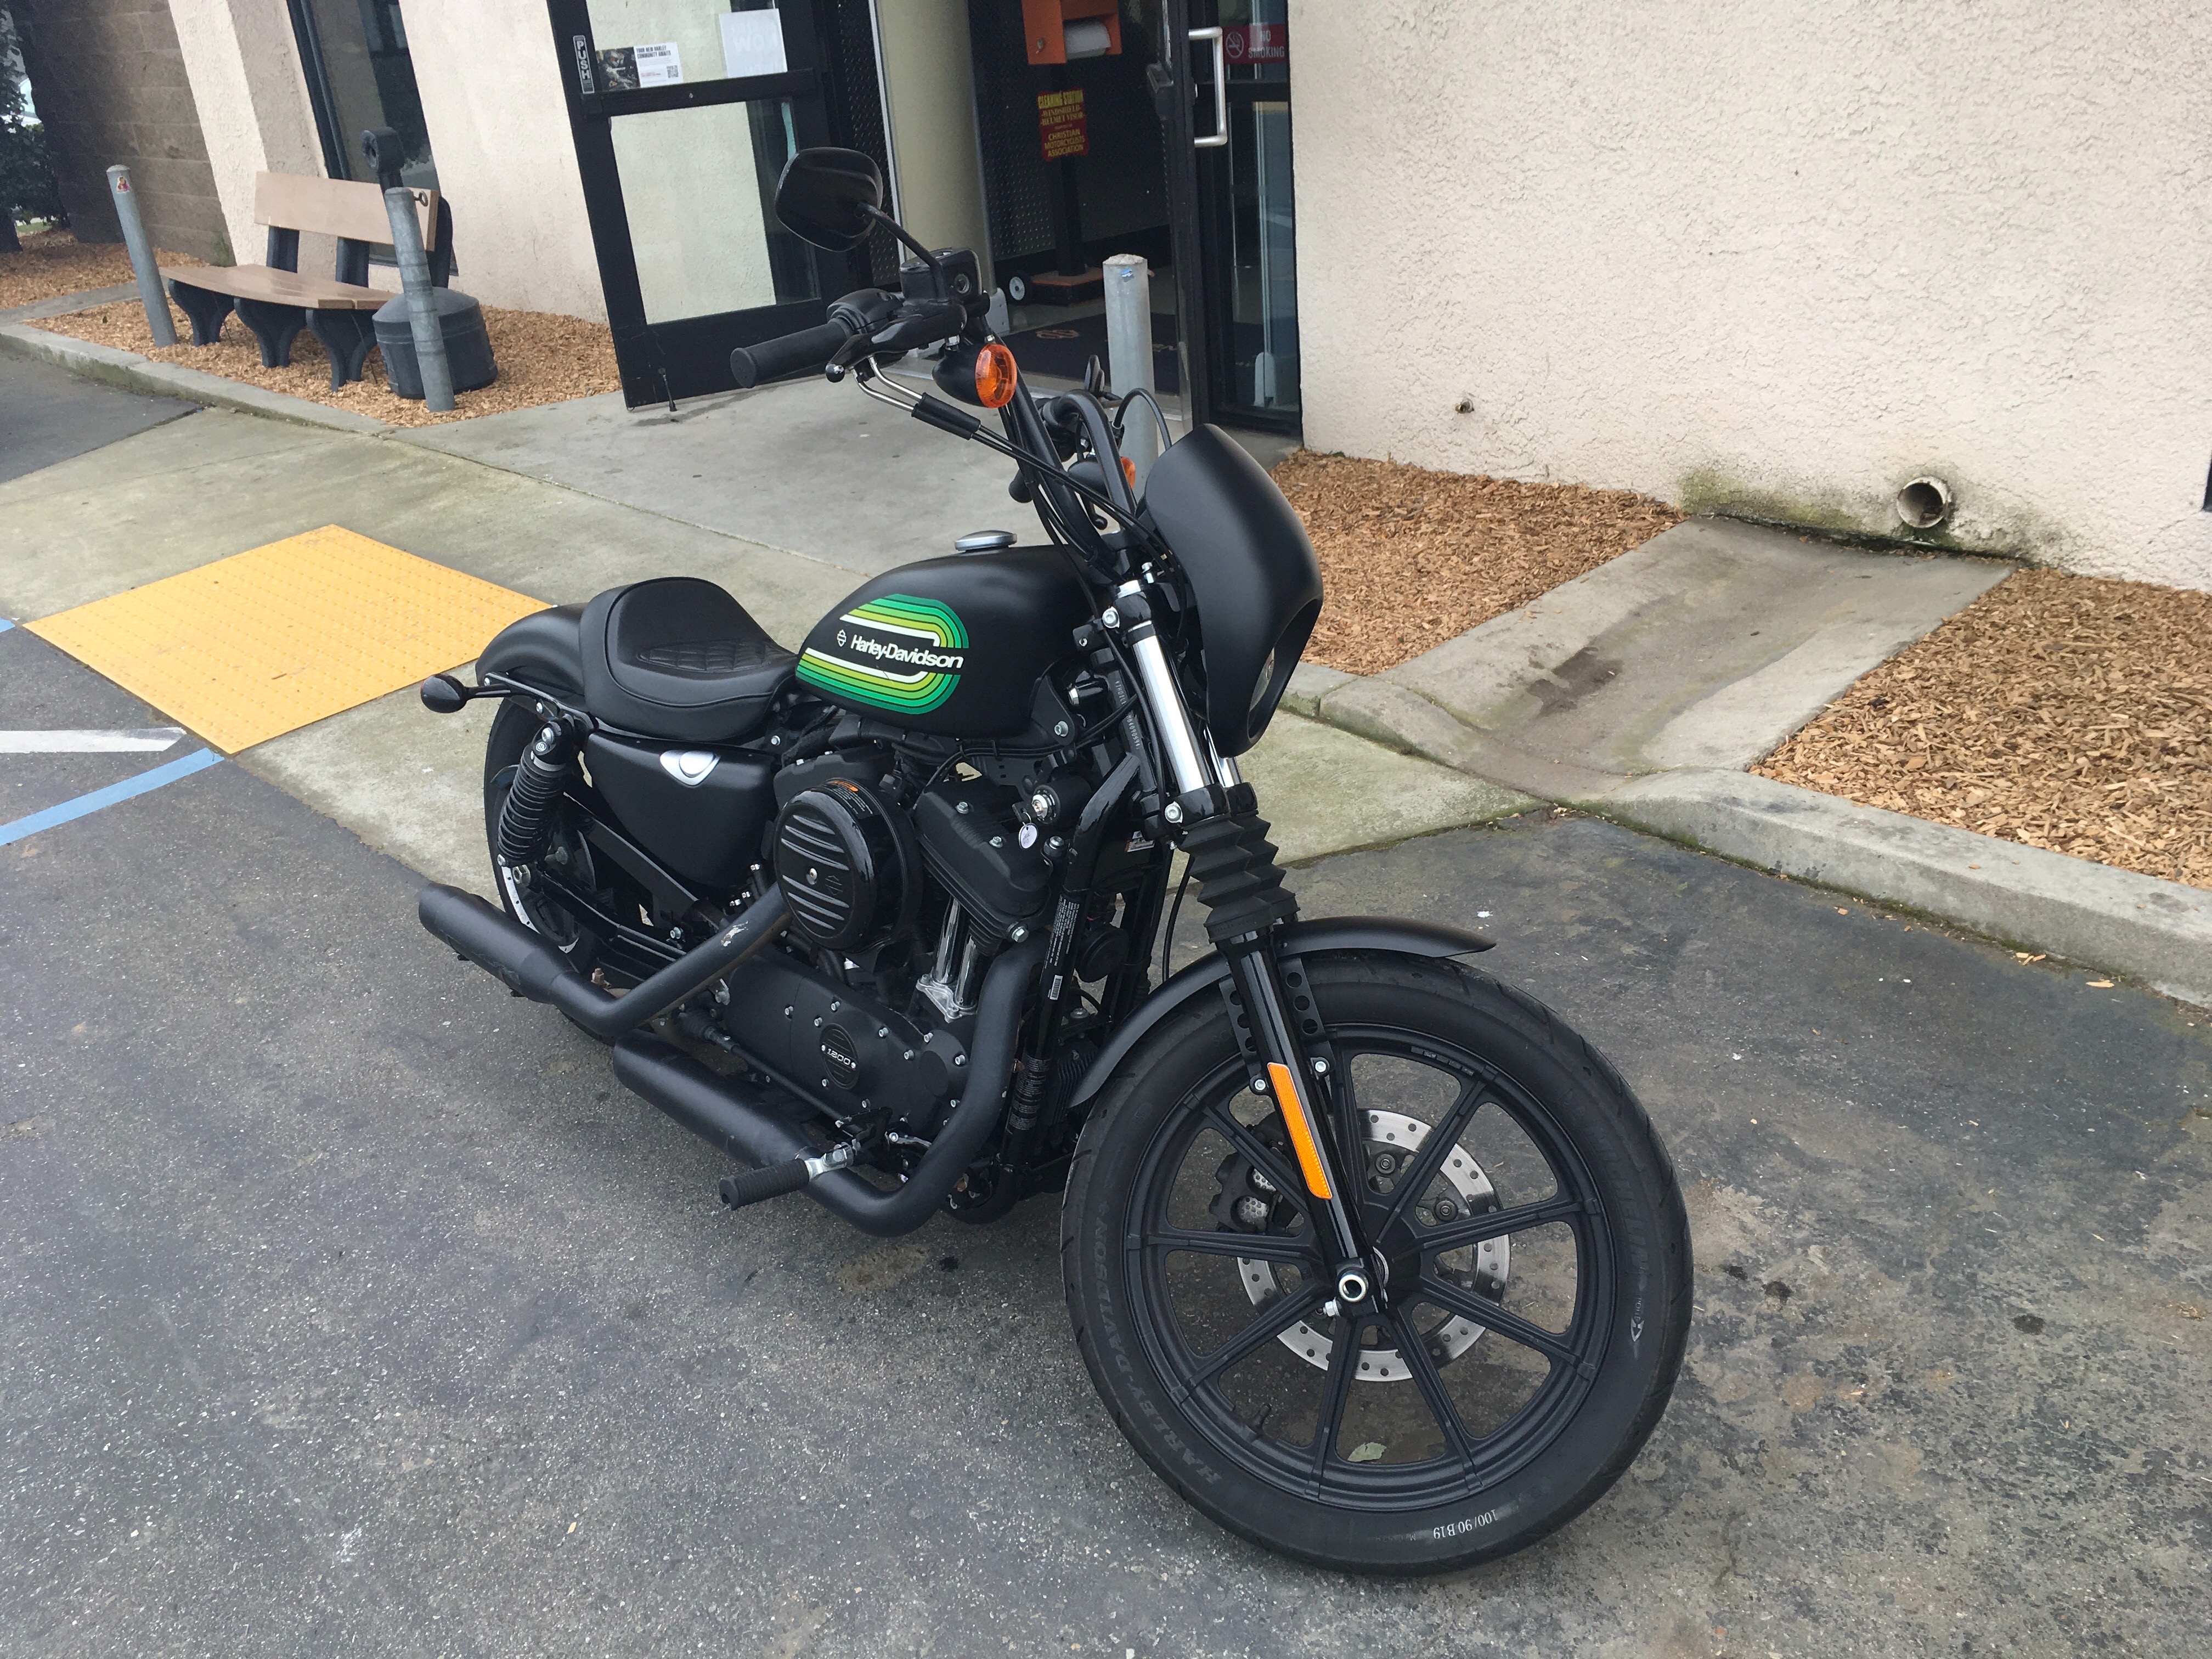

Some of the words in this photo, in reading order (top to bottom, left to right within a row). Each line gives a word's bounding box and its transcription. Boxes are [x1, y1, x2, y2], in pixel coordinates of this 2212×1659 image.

[1260, 30, 1271, 42] NO
[1248, 46, 1285, 59] SMOKING
[577, 41, 590, 80] PUSH
[1048, 128, 1080, 140] CHRISTIAN
[1045, 135, 1085, 149] MOTORCYCLISTS
[1048, 144, 1084, 157] ASSOCIATION
[850, 634, 964, 669] Harley-Davidson
[826, 1048, 851, 1066] 1200
[1094, 1216, 1223, 1485] HARLEY-DAVIDSON
